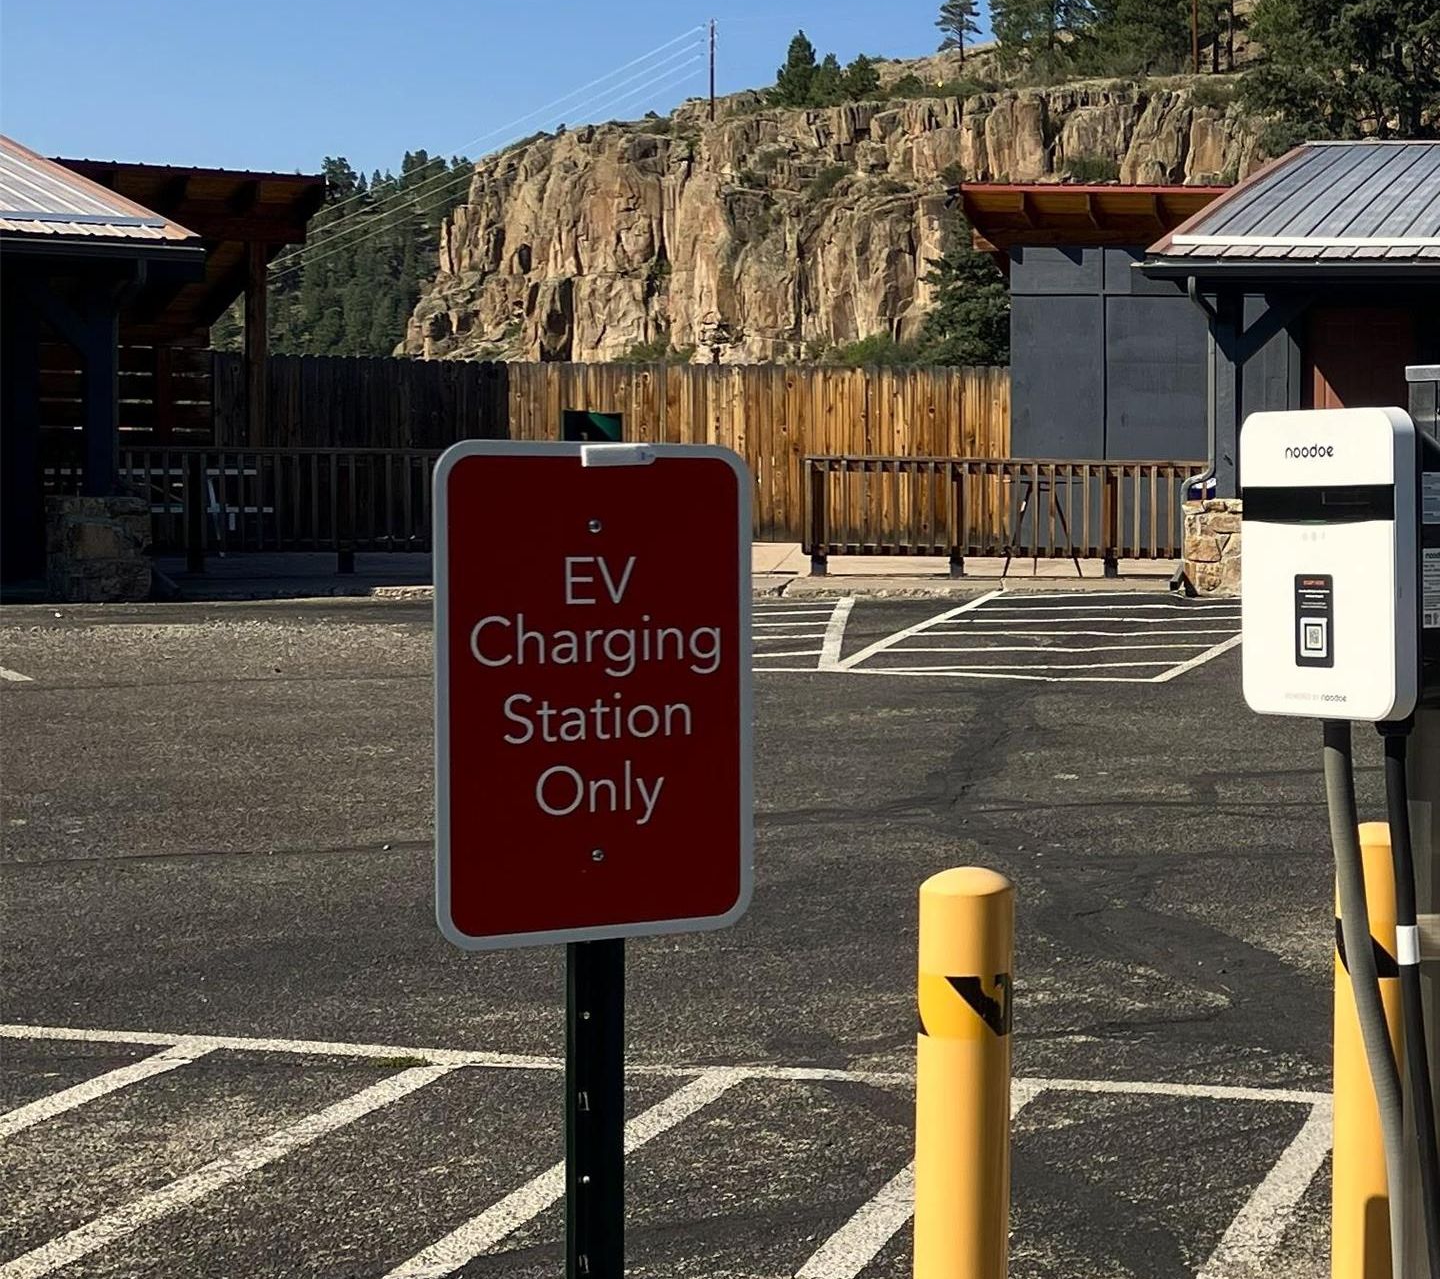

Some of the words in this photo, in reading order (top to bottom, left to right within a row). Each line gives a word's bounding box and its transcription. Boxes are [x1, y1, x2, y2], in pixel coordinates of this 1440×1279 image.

[1285, 443, 1334, 459] noodoe
[565, 555, 636, 605] EV
[470, 613, 722, 677] Charging
[503, 692, 692, 744] Station
[536, 760, 665, 825] Only
